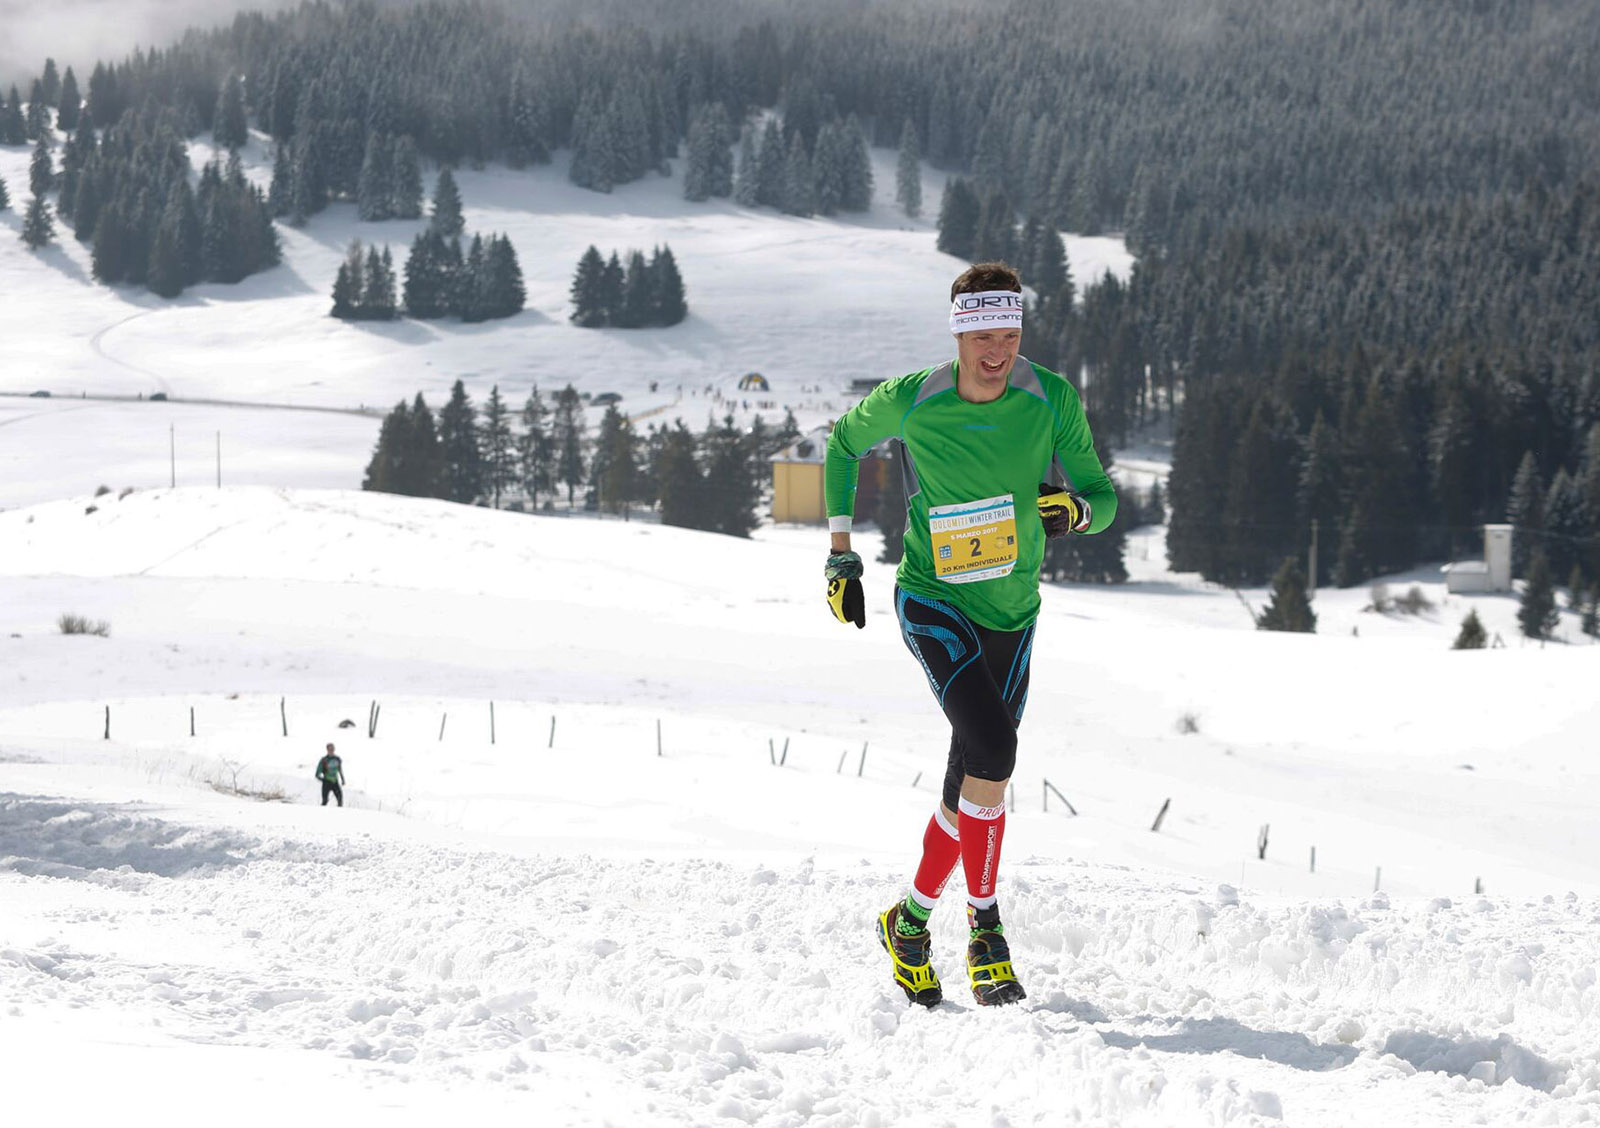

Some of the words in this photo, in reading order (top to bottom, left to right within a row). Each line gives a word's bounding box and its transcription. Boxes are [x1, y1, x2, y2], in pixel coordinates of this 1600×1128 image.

[956, 316, 979, 324] micro
[933, 519, 968, 529] DOLOMITI
[968, 513, 993, 524] WINTER
[994, 509, 1011, 519] TRAIL
[956, 531, 981, 539] MARZO
[982, 527, 998, 535] 2017
[969, 537, 982, 557] 2
[966, 554, 1013, 569] INDIVIDUALE
